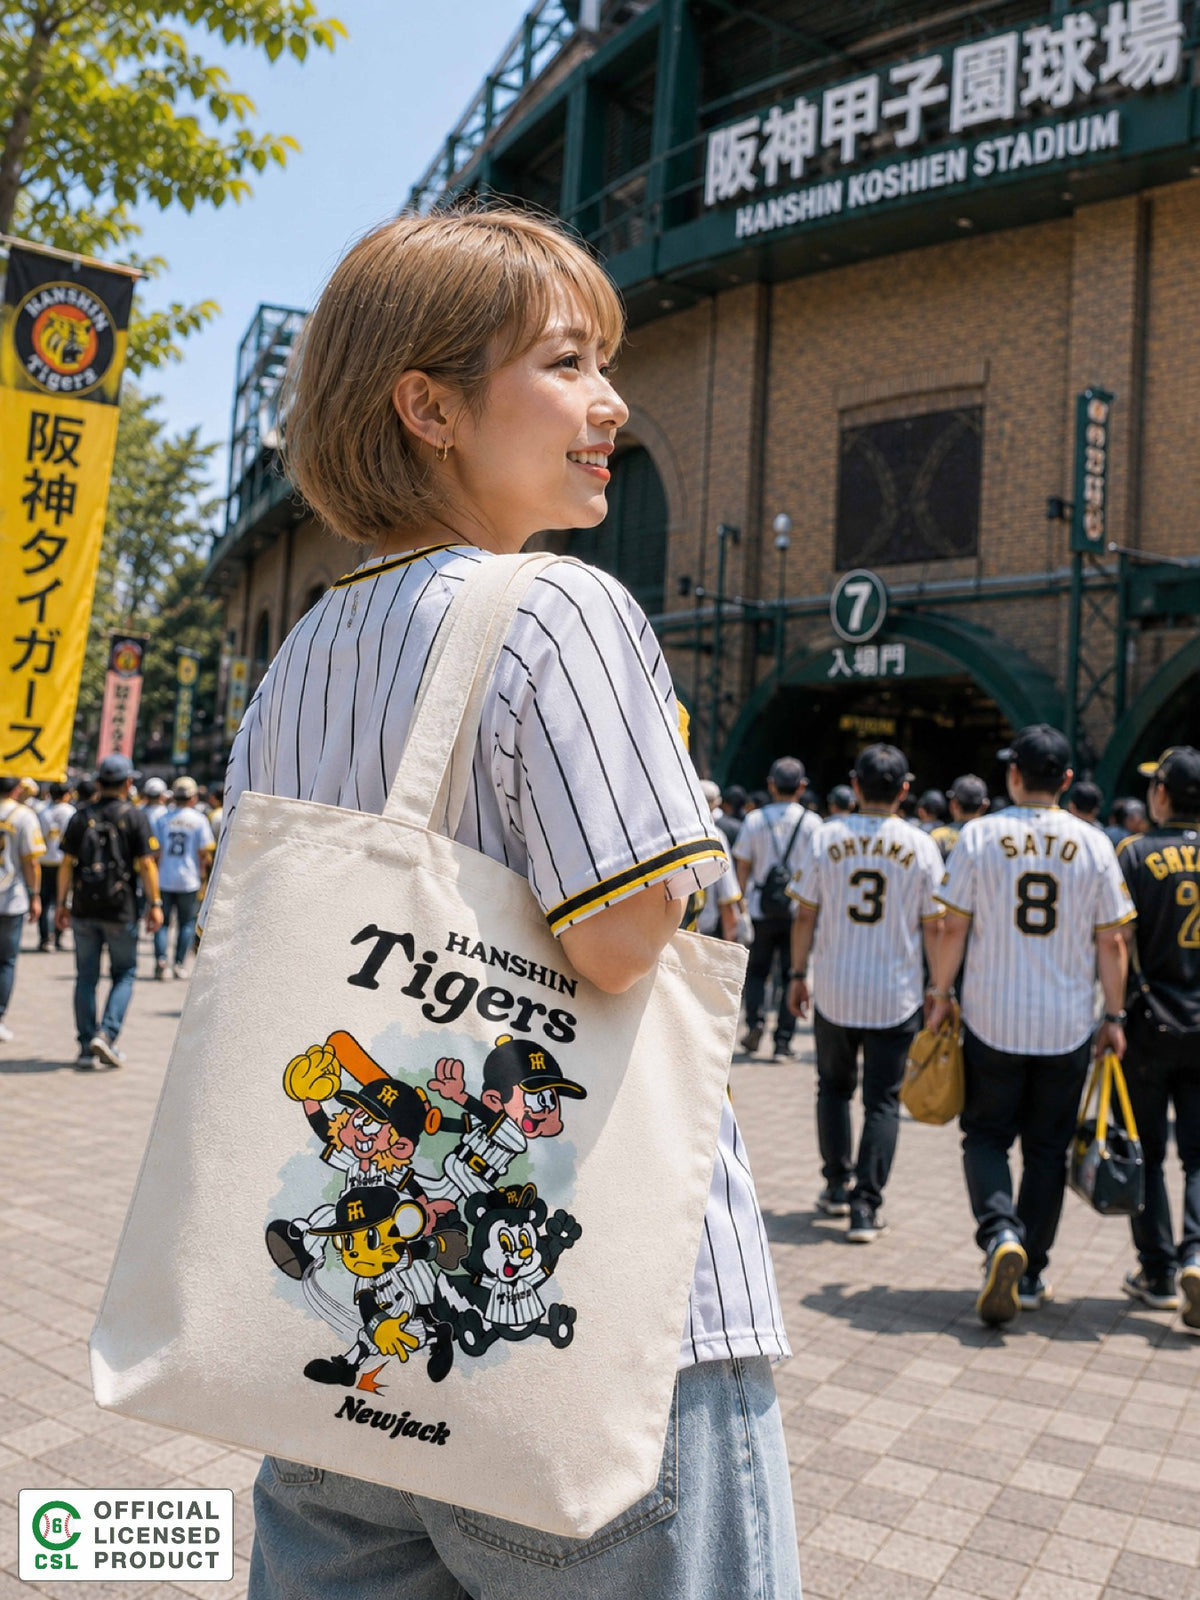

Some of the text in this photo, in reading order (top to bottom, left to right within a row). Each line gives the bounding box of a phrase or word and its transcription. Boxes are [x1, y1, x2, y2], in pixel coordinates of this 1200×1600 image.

[704, 0, 1184, 206] 阪神甲子園球場
[735, 110, 1120, 238] HANSHIN KOSHIEN STADIUM
[24, 286, 109, 332] HANSHIN
[4, 410, 84, 764] 阪神タイガース
[844, 582, 873, 632] 7
[827, 836, 916, 870] OHYAMA
[1000, 834, 1079, 862] SATO
[847, 868, 886, 927] 3
[1014, 870, 1059, 937] 8
[347, 923, 577, 1043] Tigers
[445, 931, 578, 998] HANSHIN
[335, 1396, 451, 1446] Newjack
